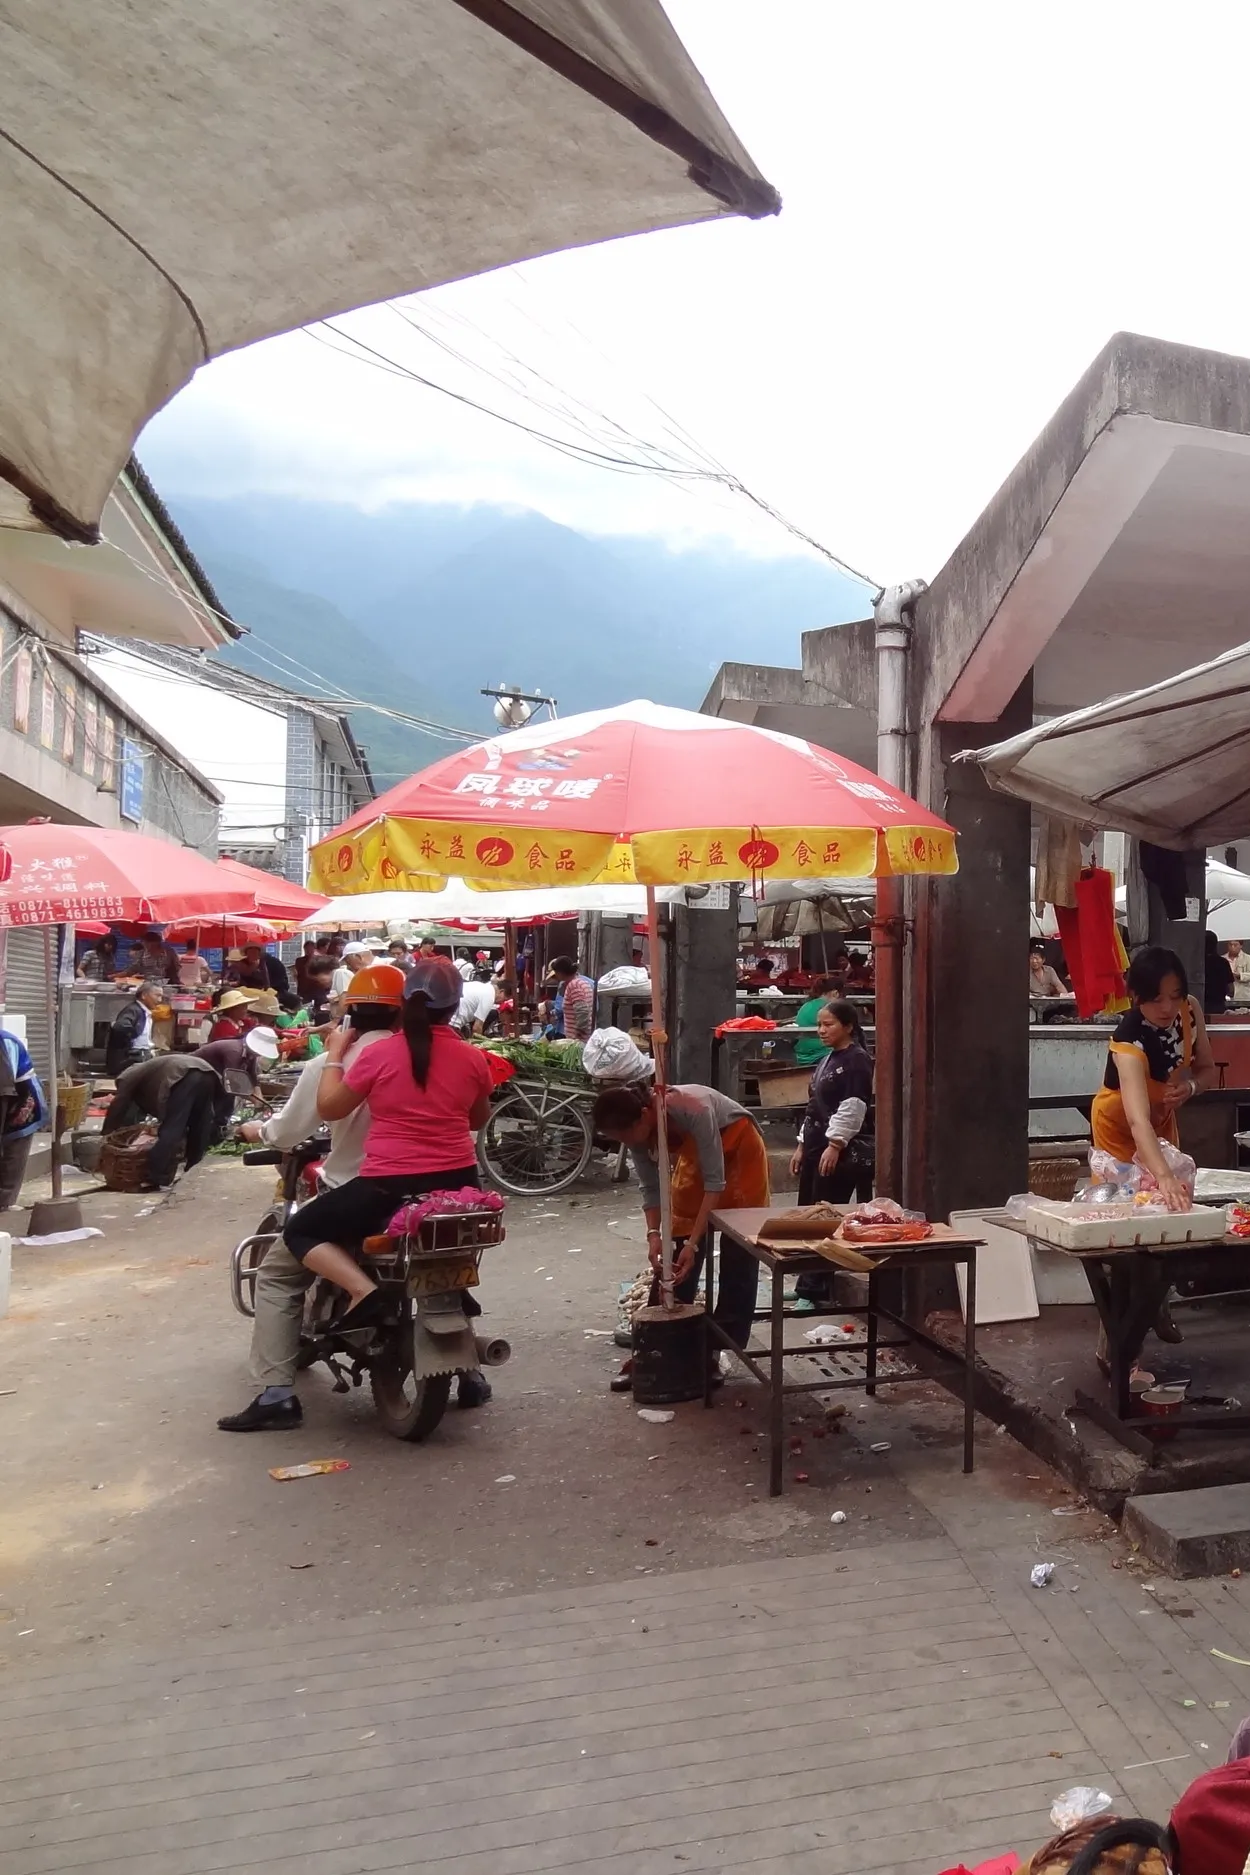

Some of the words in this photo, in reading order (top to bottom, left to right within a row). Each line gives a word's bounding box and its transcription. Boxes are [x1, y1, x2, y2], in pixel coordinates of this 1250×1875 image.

[419, 832, 467, 860] 永益
[524, 841, 577, 872] 食品
[675, 840, 729, 872] 永益
[791, 839, 841, 867] 食品
